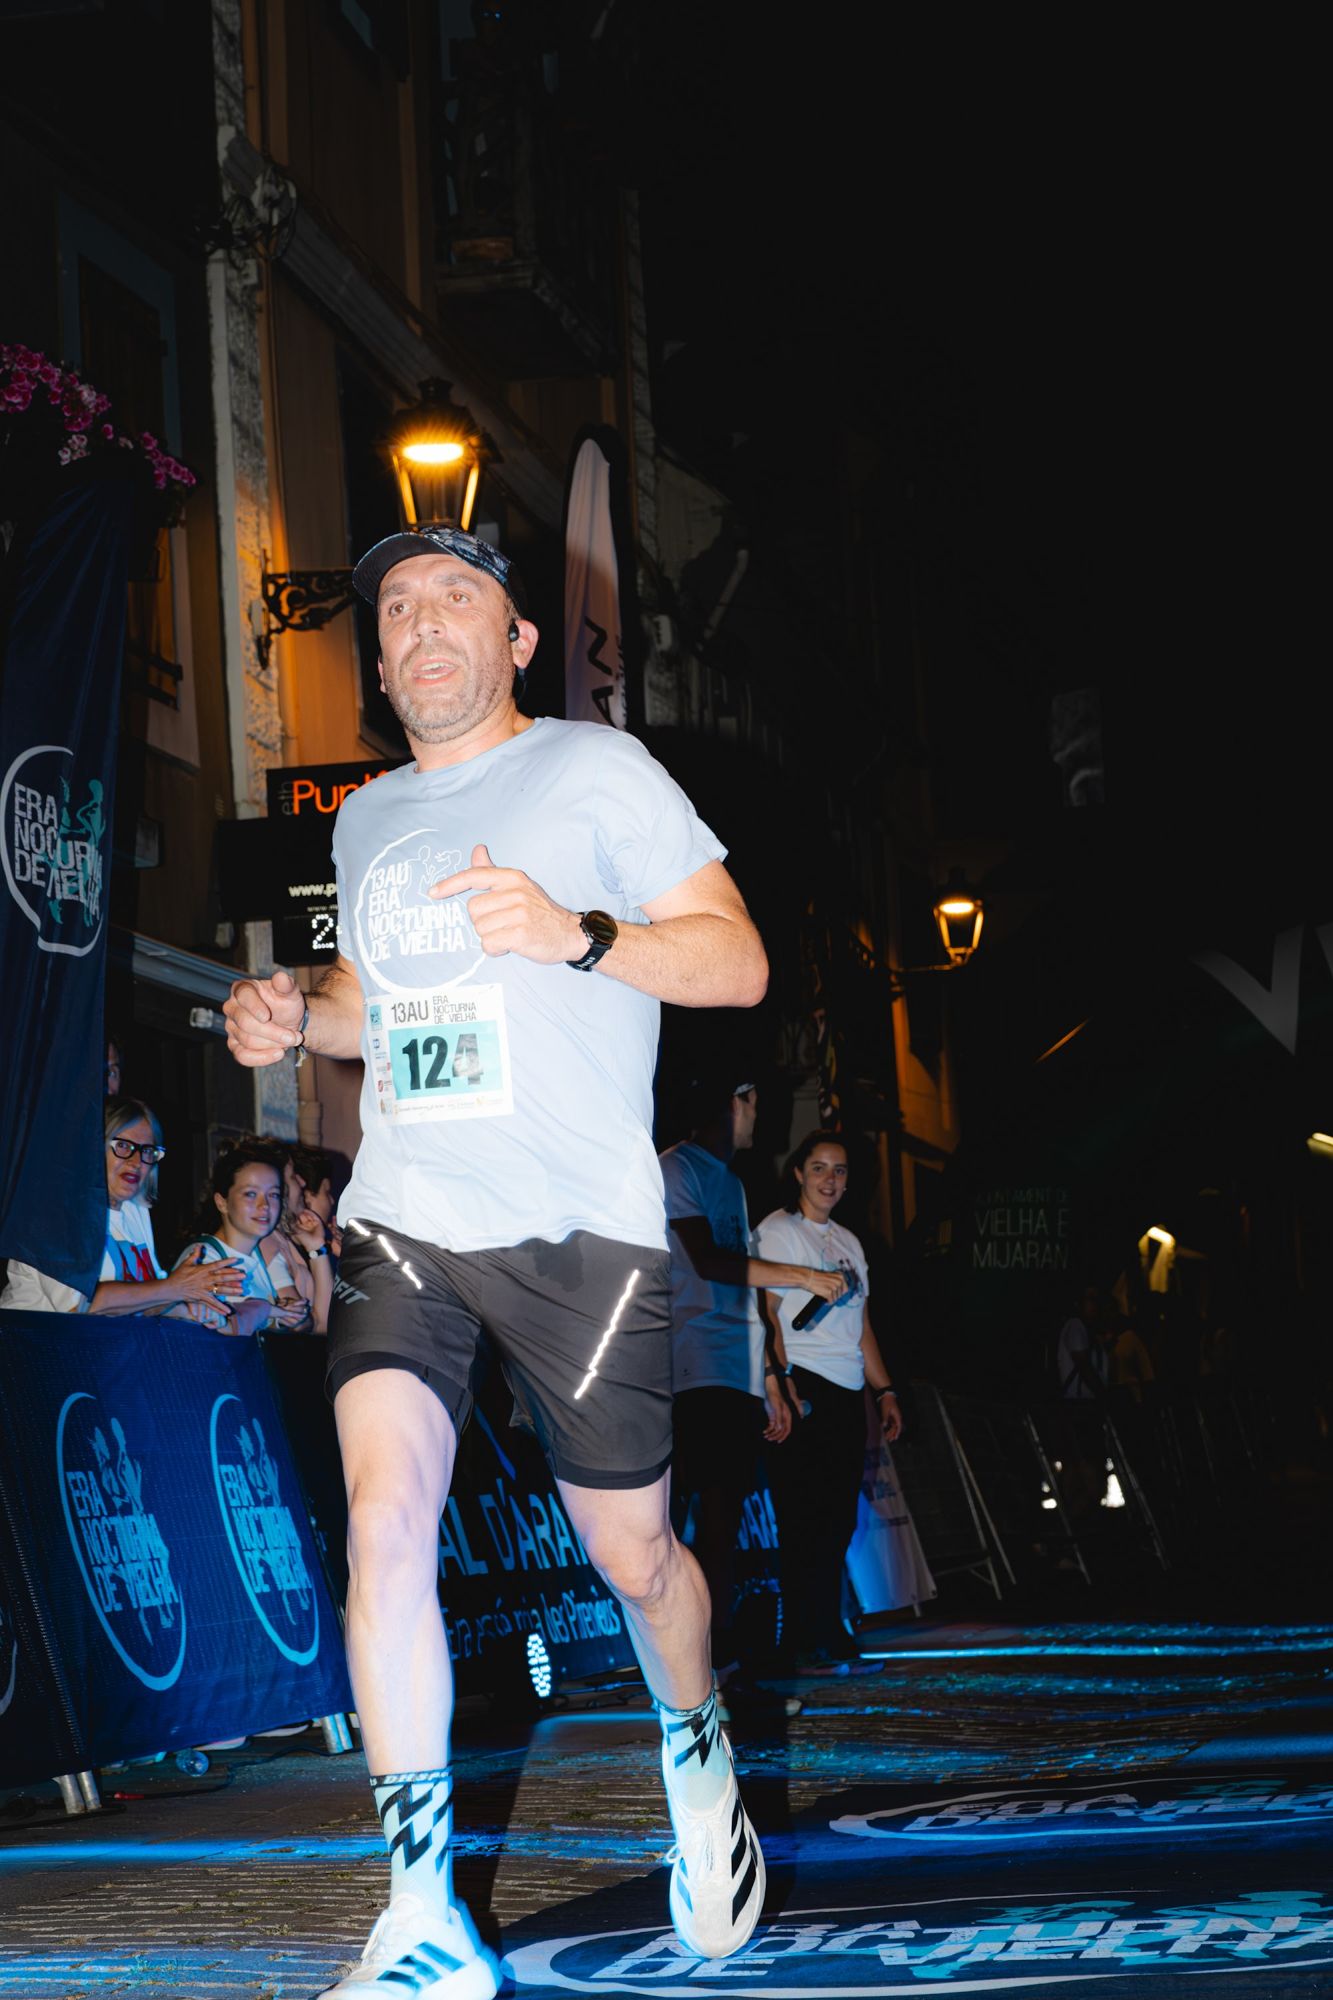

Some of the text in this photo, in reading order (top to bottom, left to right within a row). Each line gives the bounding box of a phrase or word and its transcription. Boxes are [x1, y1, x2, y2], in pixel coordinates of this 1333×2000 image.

[14, 782, 58, 830] ERA
[15, 848, 46, 888] DE
[370, 861, 410, 891] 13AU
[367, 902, 466, 940] NOCTURNA
[368, 886, 401, 917] ERA
[369, 927, 467, 963] DE VIELHA
[391, 999, 430, 1024] 13AU
[432, 995, 449, 1005] ERA
[433, 1002, 477, 1015] NOCTURNA
[434, 1012, 478, 1024] DE VIELHA
[402, 1032, 485, 1091] 124
[66, 1470, 108, 1517] ERA
[219, 1464, 255, 1507] ERA
[79, 1513, 169, 1565] NOCTURNA
[439, 1494, 489, 1580] AL
[93, 1566, 123, 1613] DE
[243, 1550, 271, 1594] DE
[589, 1957, 776, 1979] DE
